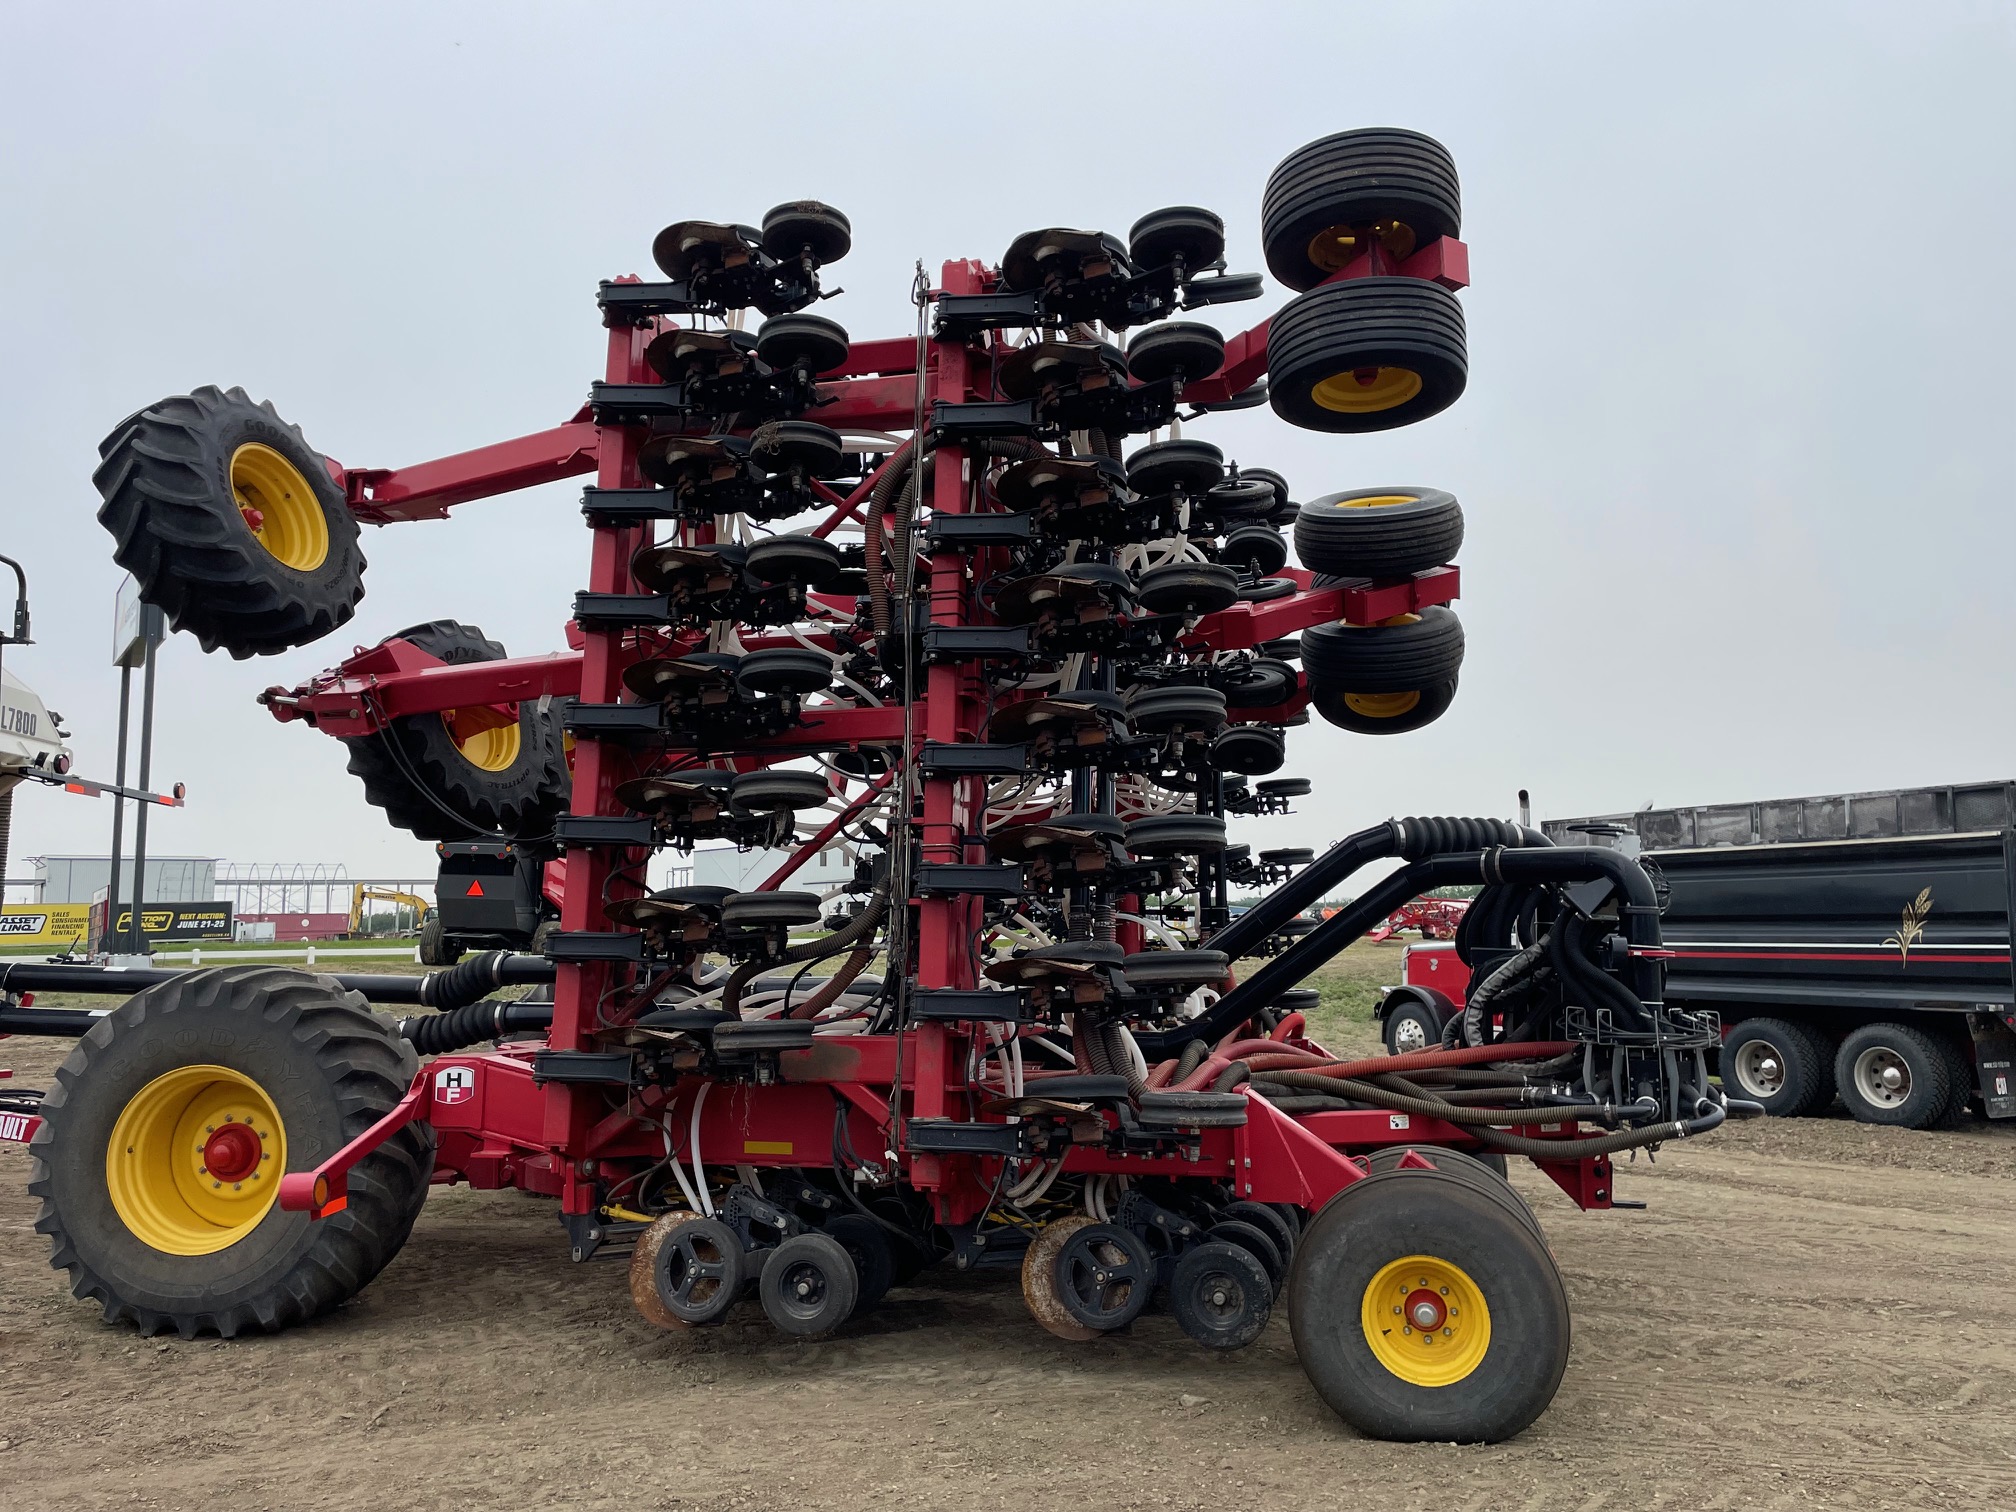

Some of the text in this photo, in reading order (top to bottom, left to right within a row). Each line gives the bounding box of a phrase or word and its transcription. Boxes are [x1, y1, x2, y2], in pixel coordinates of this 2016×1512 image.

[1, 705, 37, 736] L7800
[0, 916, 41, 924] ASSET
[177, 920, 225, 929] JUNE 21-25
[446, 1072, 462, 1087] H
[446, 1088, 461, 1102] F
